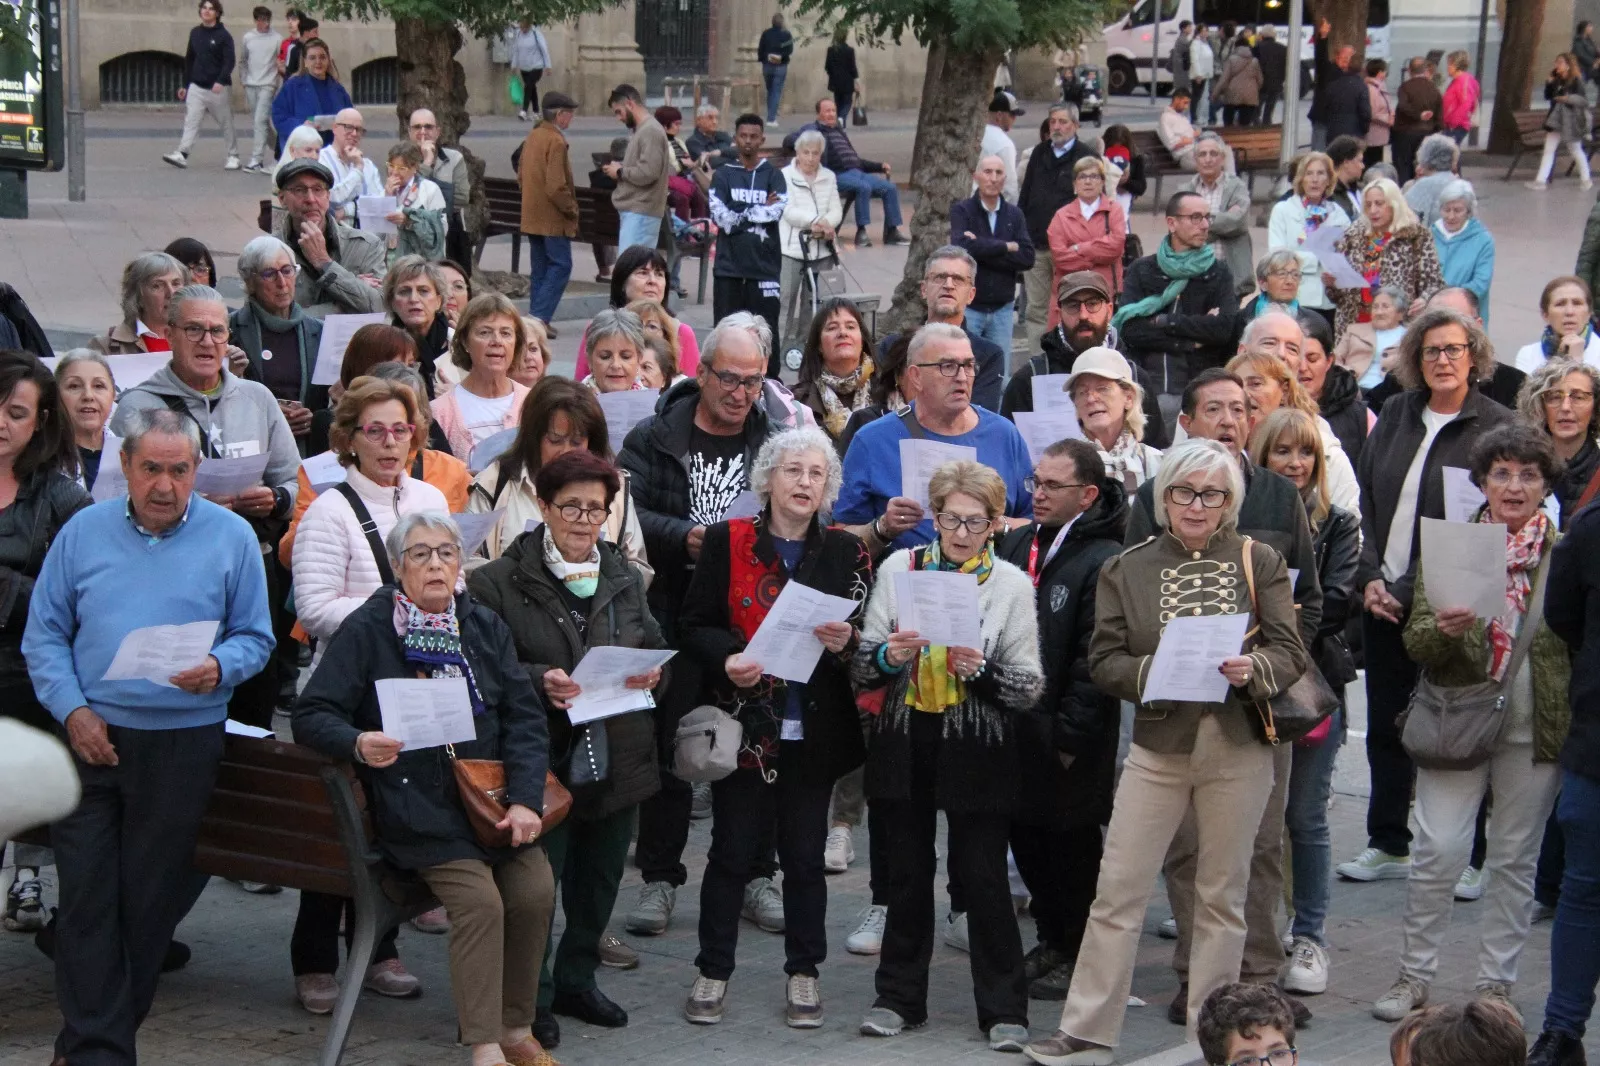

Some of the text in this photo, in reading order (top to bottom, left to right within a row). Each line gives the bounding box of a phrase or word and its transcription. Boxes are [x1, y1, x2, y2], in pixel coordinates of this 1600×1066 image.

[32, 129, 40, 141] 2
[28, 141, 44, 151] NOV
[731, 188, 768, 204] NEVER
